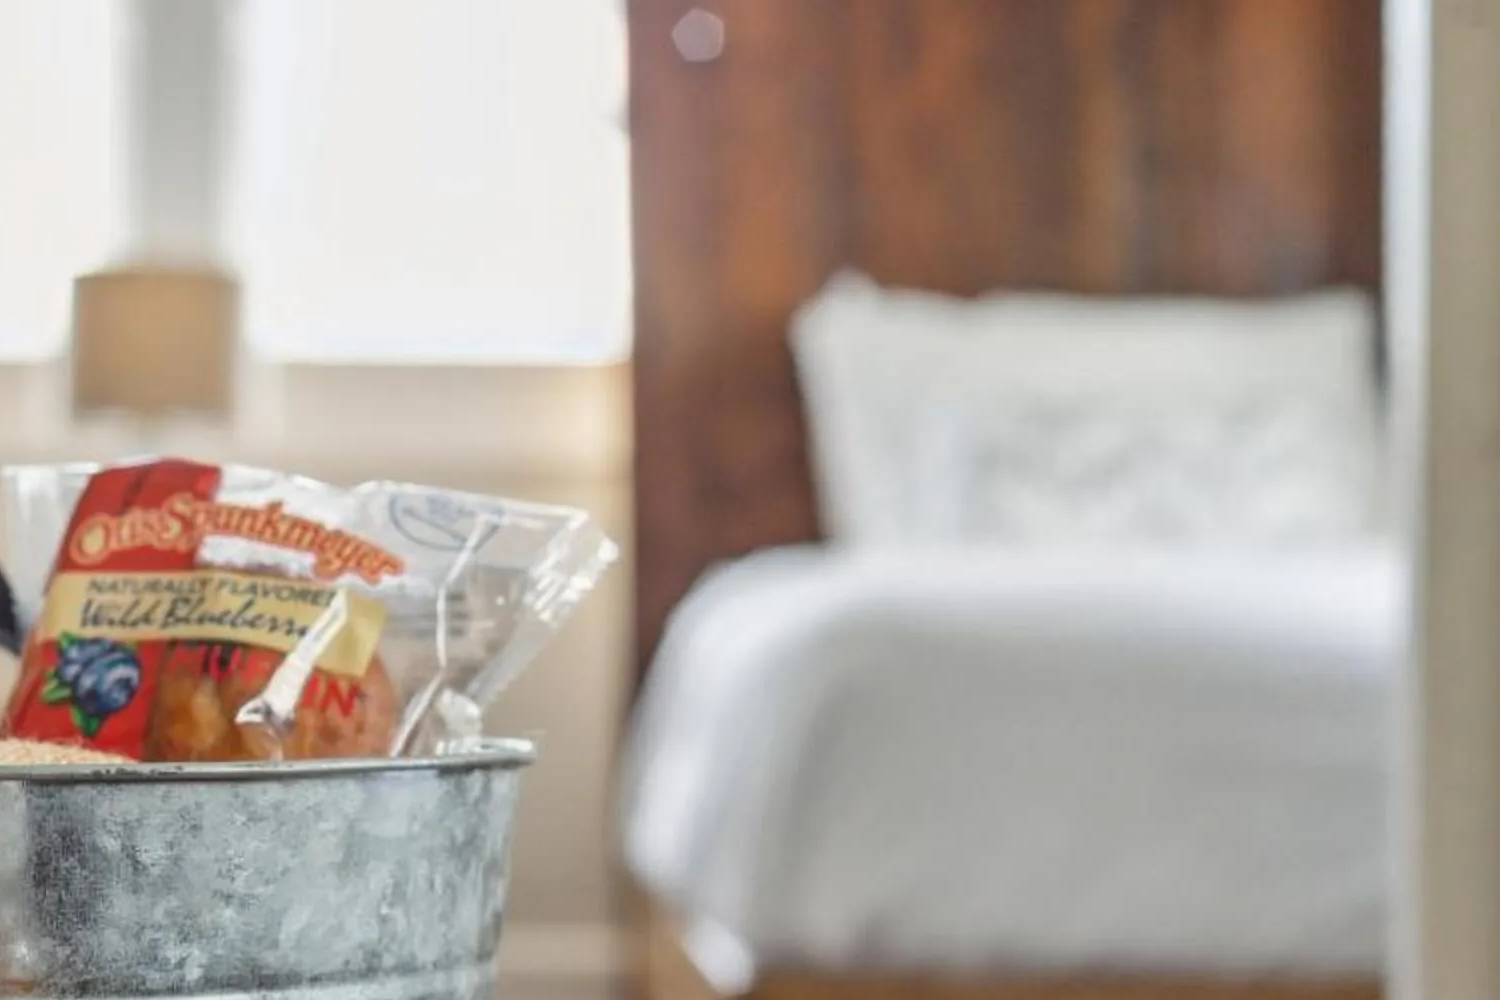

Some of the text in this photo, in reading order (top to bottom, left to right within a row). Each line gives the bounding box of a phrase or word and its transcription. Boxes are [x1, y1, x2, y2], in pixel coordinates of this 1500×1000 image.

[88, 577, 208, 597] NATURALLY
[80, 595, 308, 637] Wild Blueberr
